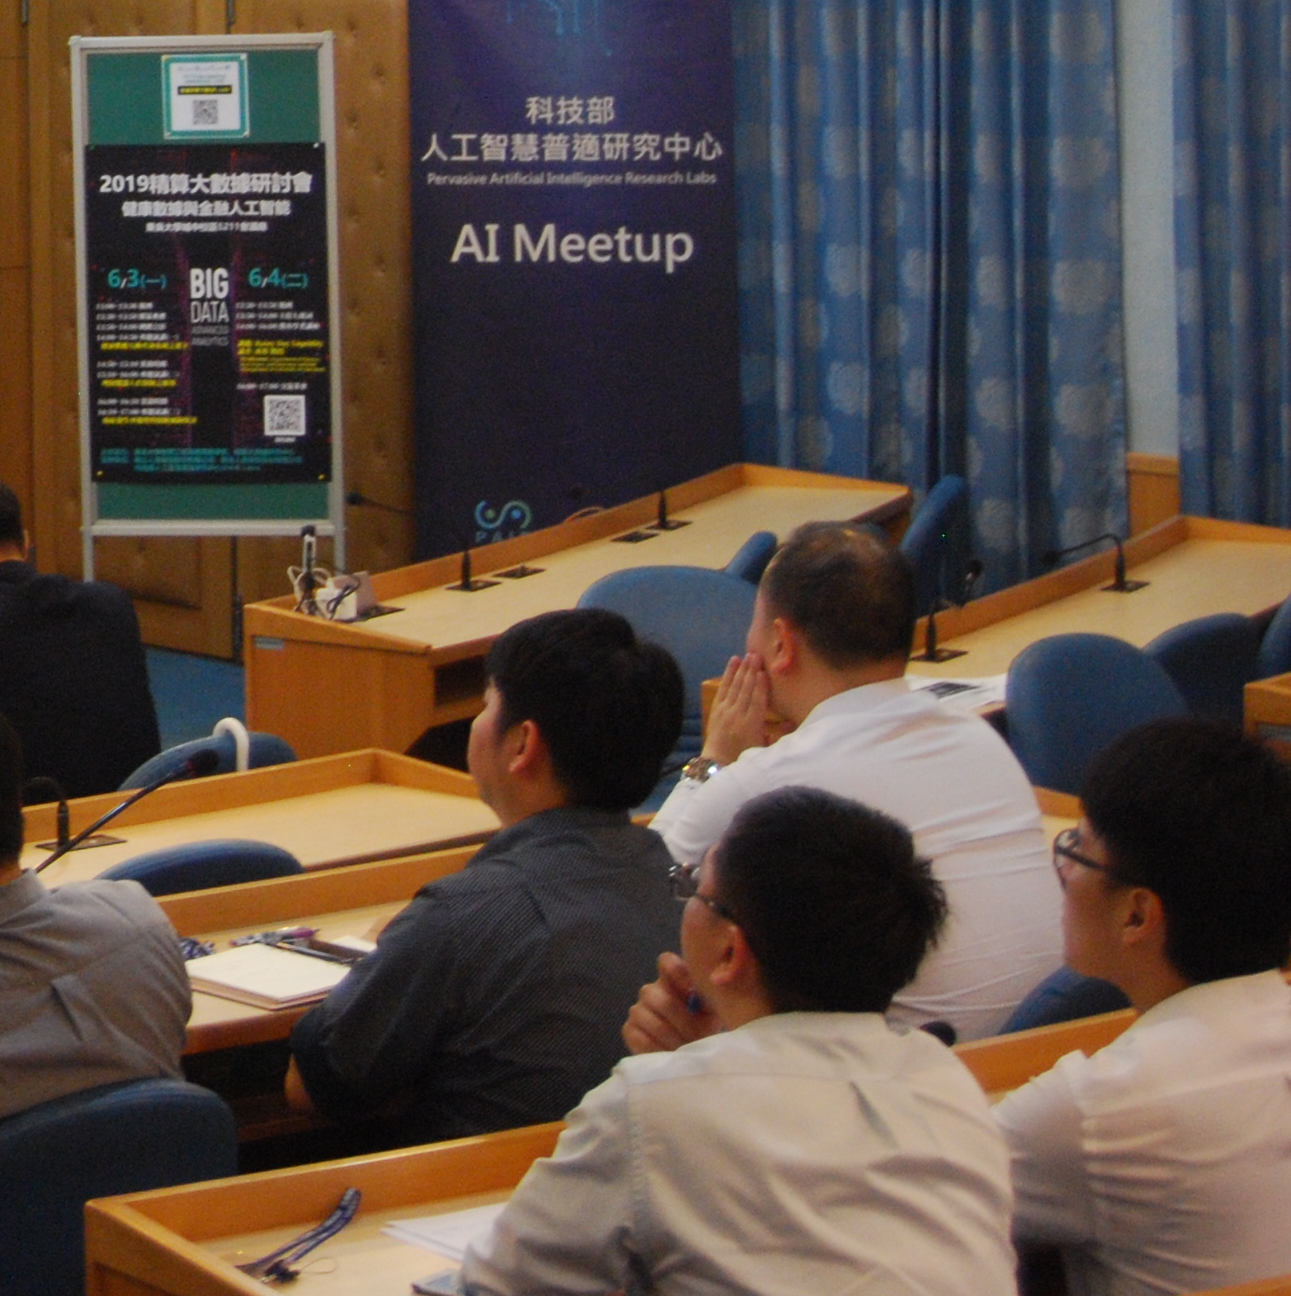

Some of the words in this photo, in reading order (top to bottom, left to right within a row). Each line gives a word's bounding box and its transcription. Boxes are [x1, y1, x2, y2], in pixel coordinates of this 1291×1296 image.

[525, 95, 616, 125] 科技部
[420, 132, 724, 163] 人工智慧普適研究中心
[427, 172, 487, 185] Pervasive
[489, 171, 544, 185] Artificial
[546, 171, 622, 188] Intelligence
[624, 171, 683, 185] Research
[686, 171, 718, 185] Labs
[450, 223, 500, 263] AI
[513, 222, 694, 273] Meetup
[190, 267, 229, 299] BIG
[190, 300, 230, 323] DATA
